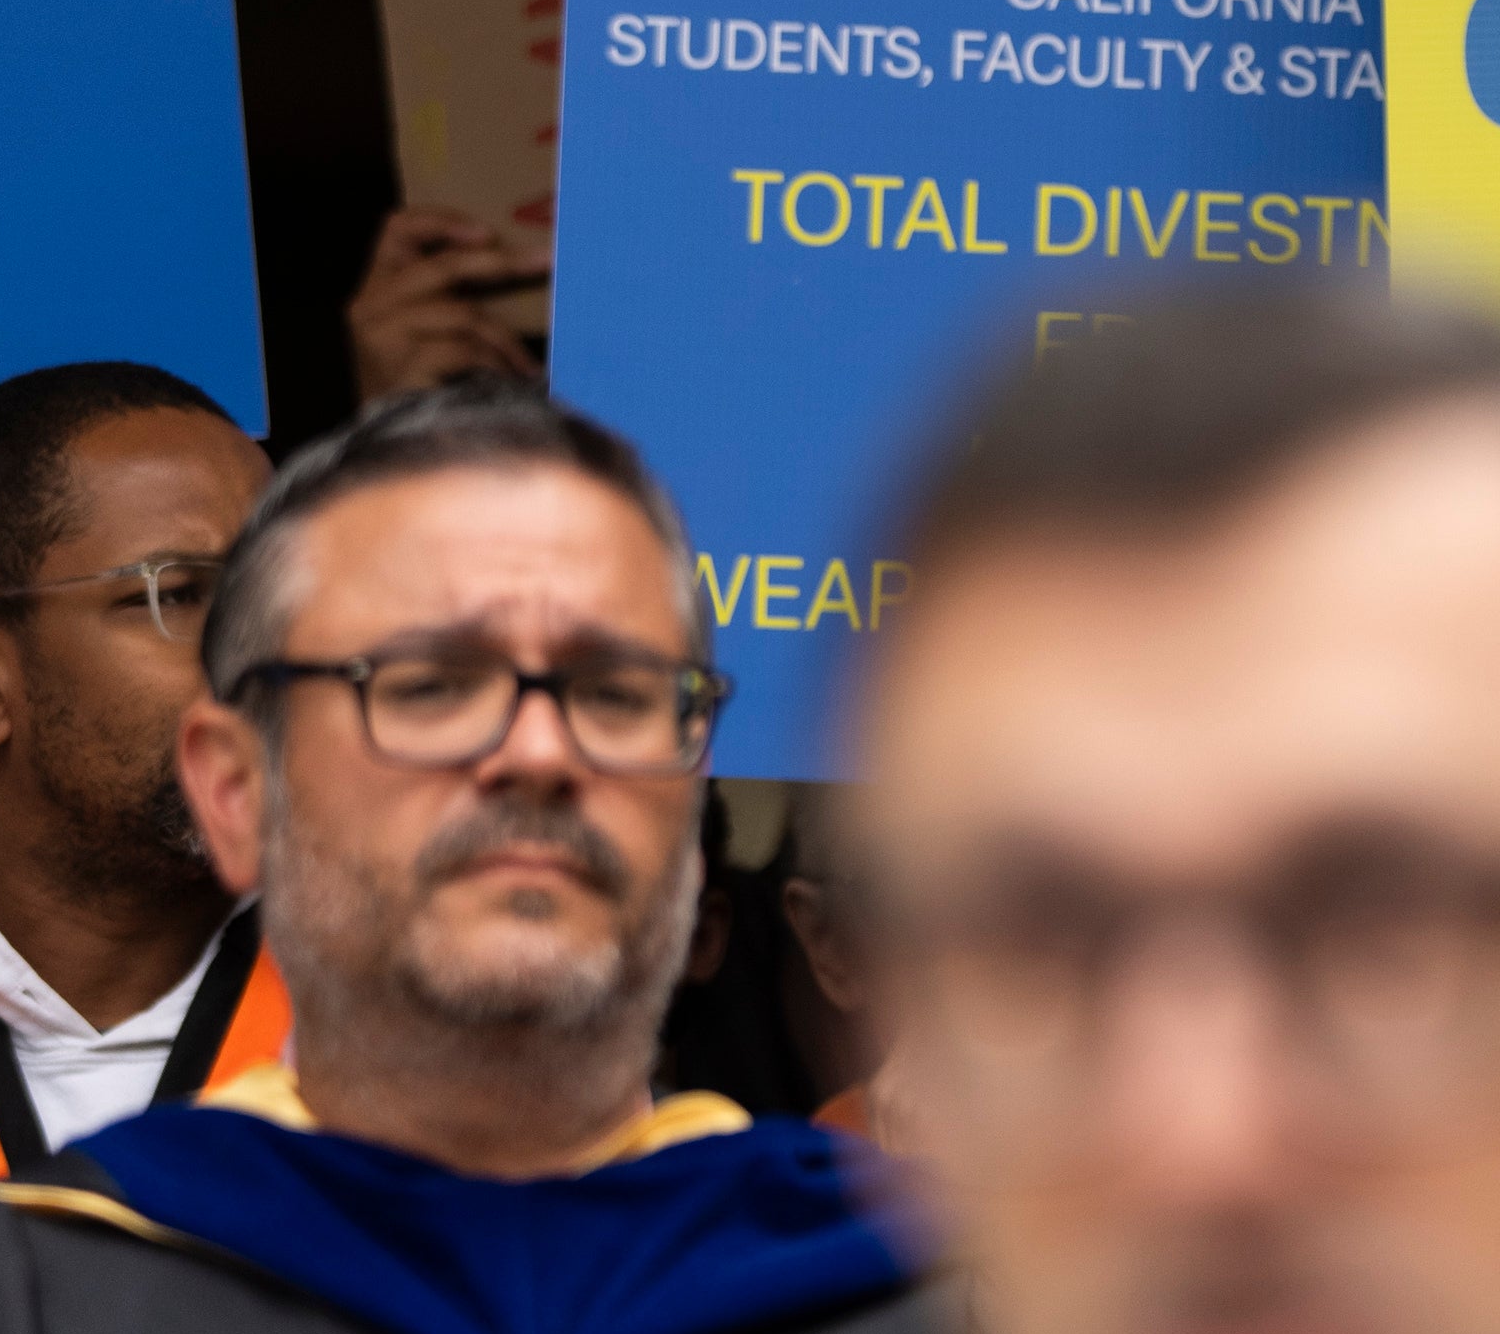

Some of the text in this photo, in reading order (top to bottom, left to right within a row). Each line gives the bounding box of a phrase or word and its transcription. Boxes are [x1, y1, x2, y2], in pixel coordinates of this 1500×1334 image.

[606, 12, 1385, 101] STUDENTS, FACULTY & STA
[733, 169, 1008, 254] TOTAL
